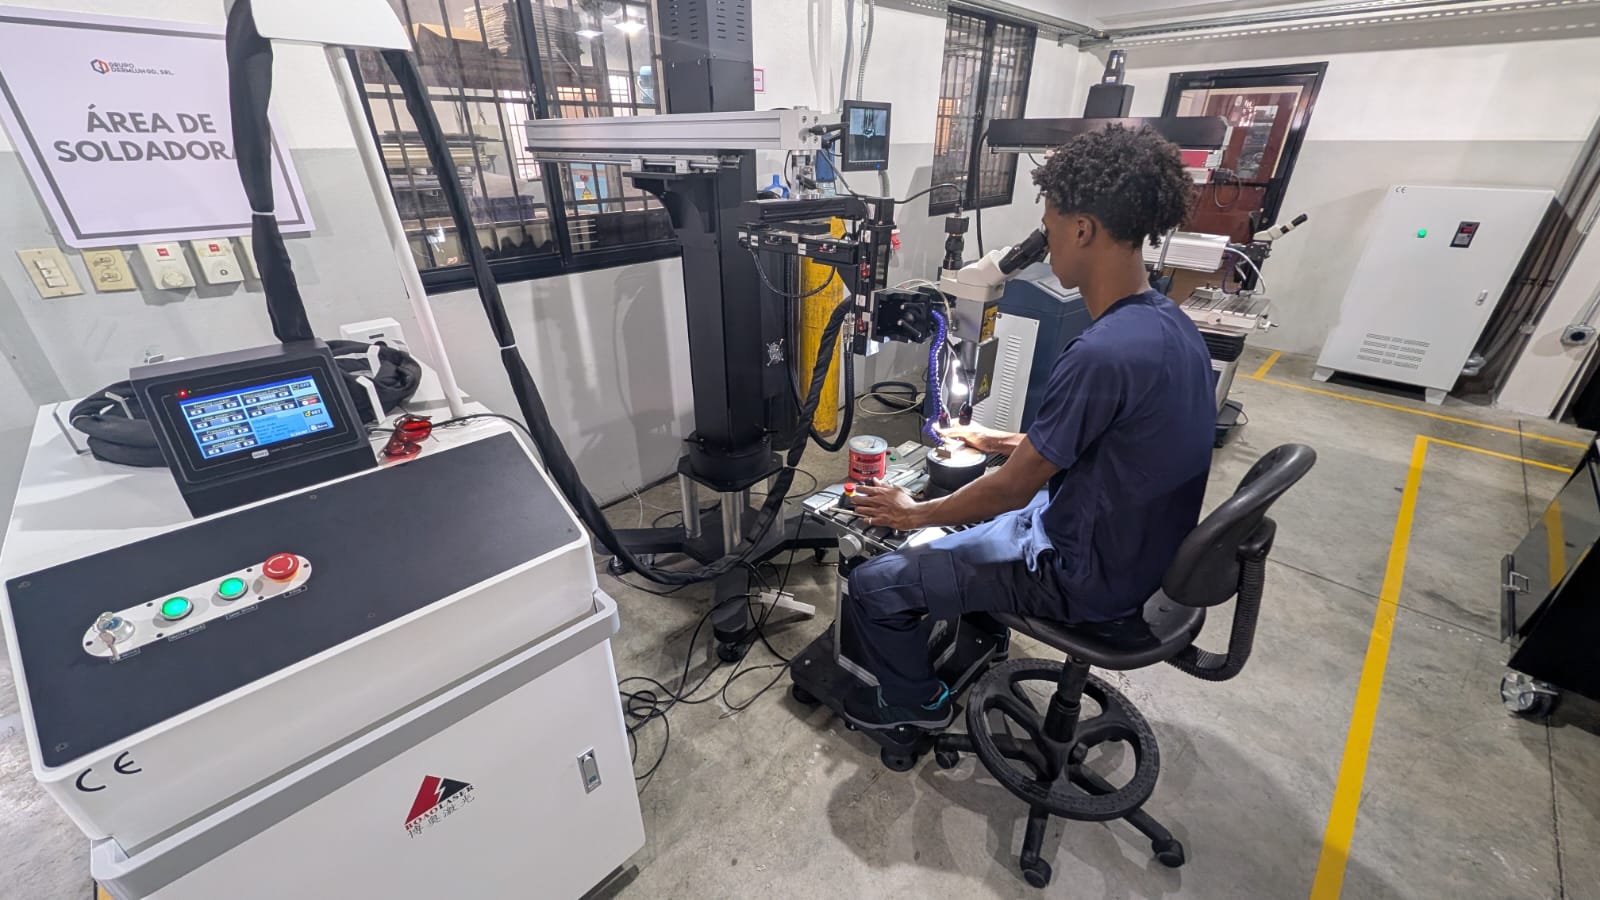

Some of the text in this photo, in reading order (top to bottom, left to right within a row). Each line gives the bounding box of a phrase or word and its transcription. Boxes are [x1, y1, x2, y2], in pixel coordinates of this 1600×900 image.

[87, 103, 217, 134] ÁREA DE
[404, 785, 475, 831] BOAOLASER
